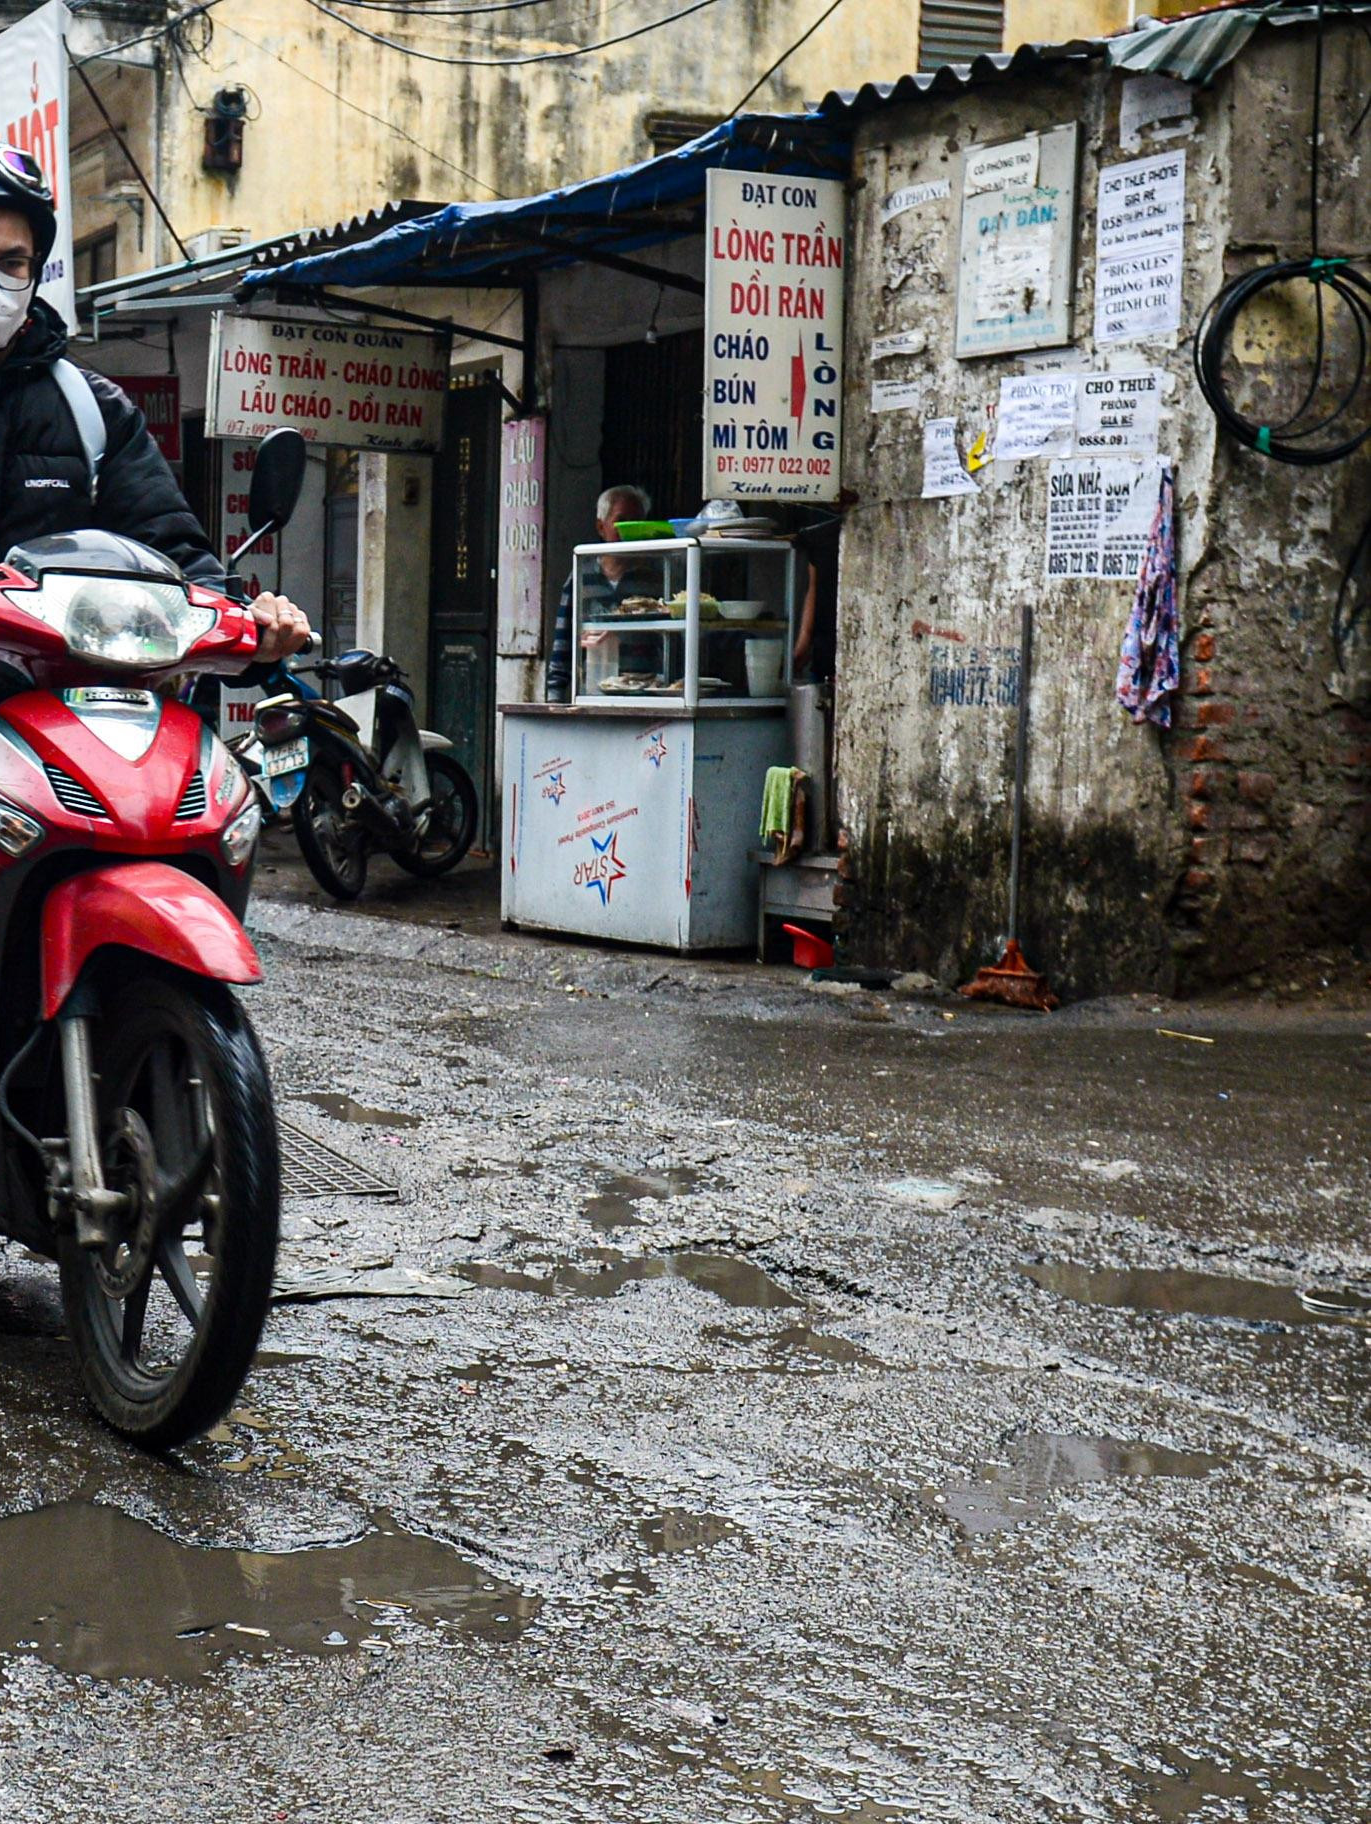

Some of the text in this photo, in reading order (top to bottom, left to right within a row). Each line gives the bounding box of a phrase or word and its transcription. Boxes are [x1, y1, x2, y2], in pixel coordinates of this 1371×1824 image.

[742, 182, 817, 208] ĐẠT CON
[713, 218, 842, 268] LÒNG TRẦN
[730, 268, 824, 320] DỒI RÁN
[272, 323, 306, 342] ĐẠT
[313, 328, 347, 344] CON
[714, 328, 769, 361] CHÁO
[223, 345, 272, 375] LÒNG
[277, 348, 326, 380] TRẦN
[343, 358, 392, 387] CHÁO
[397, 362, 446, 392] LÒNG
[1085, 373, 1156, 395] CHO THUÊ
[240, 379, 277, 415] LẨU
[281, 390, 331, 419] CHÁO
[348, 391, 380, 425] DỒI
[385, 398, 423, 428] RÁN
[713, 372, 756, 405] BÚN
[1100, 397, 1137, 411] PHÒNG
[713, 417, 788, 450] MÌ TÔM
[717, 455, 831, 475] ĐT: 0977 022 002
[1077, 466, 1102, 495] NHÀ
[85, 691, 149, 702] HONDA
[573, 854, 609, 886] STAR
